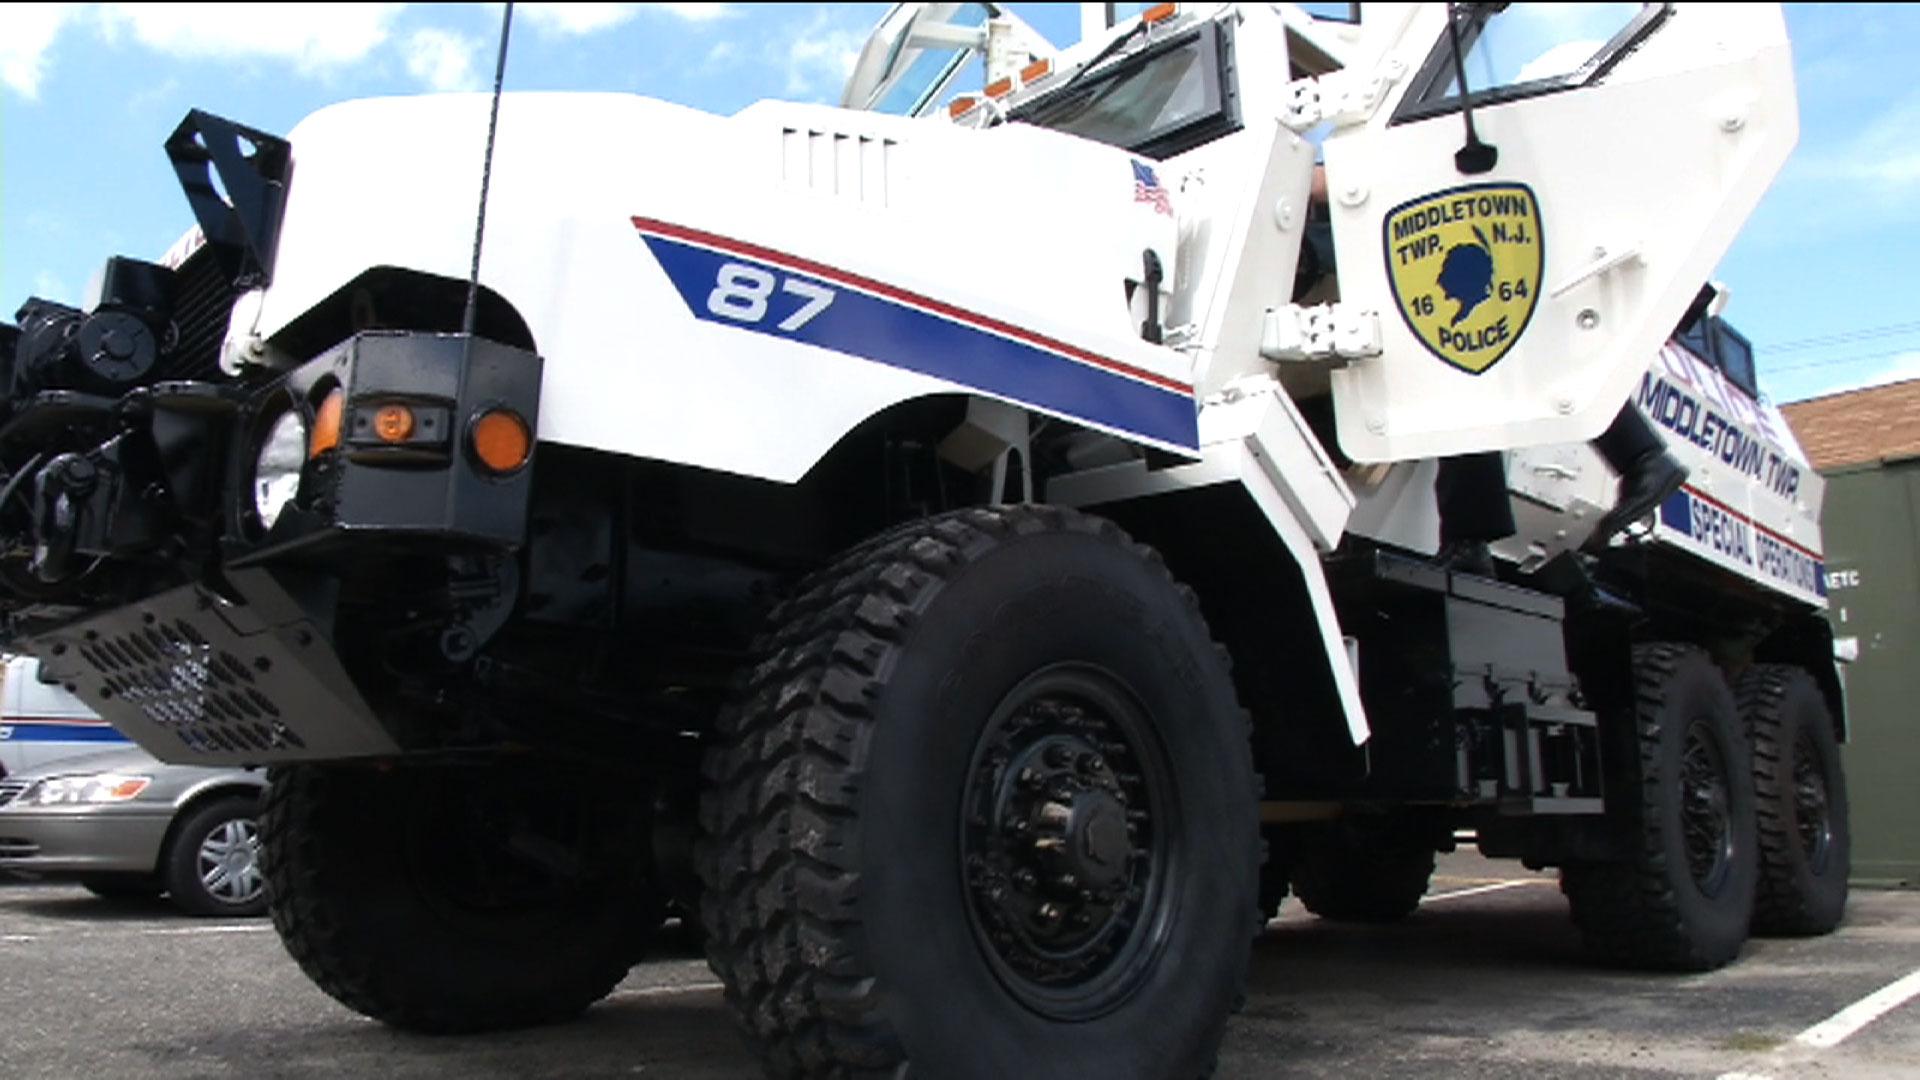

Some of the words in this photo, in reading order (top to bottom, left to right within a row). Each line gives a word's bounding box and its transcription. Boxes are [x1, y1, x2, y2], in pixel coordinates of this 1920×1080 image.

[1394, 195, 1528, 241] MIDDLETOWN
[1396, 233, 1444, 265] TWP.
[1492, 222, 1531, 244] N.J.
[707, 262, 836, 331] 87
[1411, 294, 1434, 316] 16
[1499, 278, 1528, 302] 64
[1438, 315, 1510, 352] POLICE
[1692, 498, 1753, 566] SPECIAL
